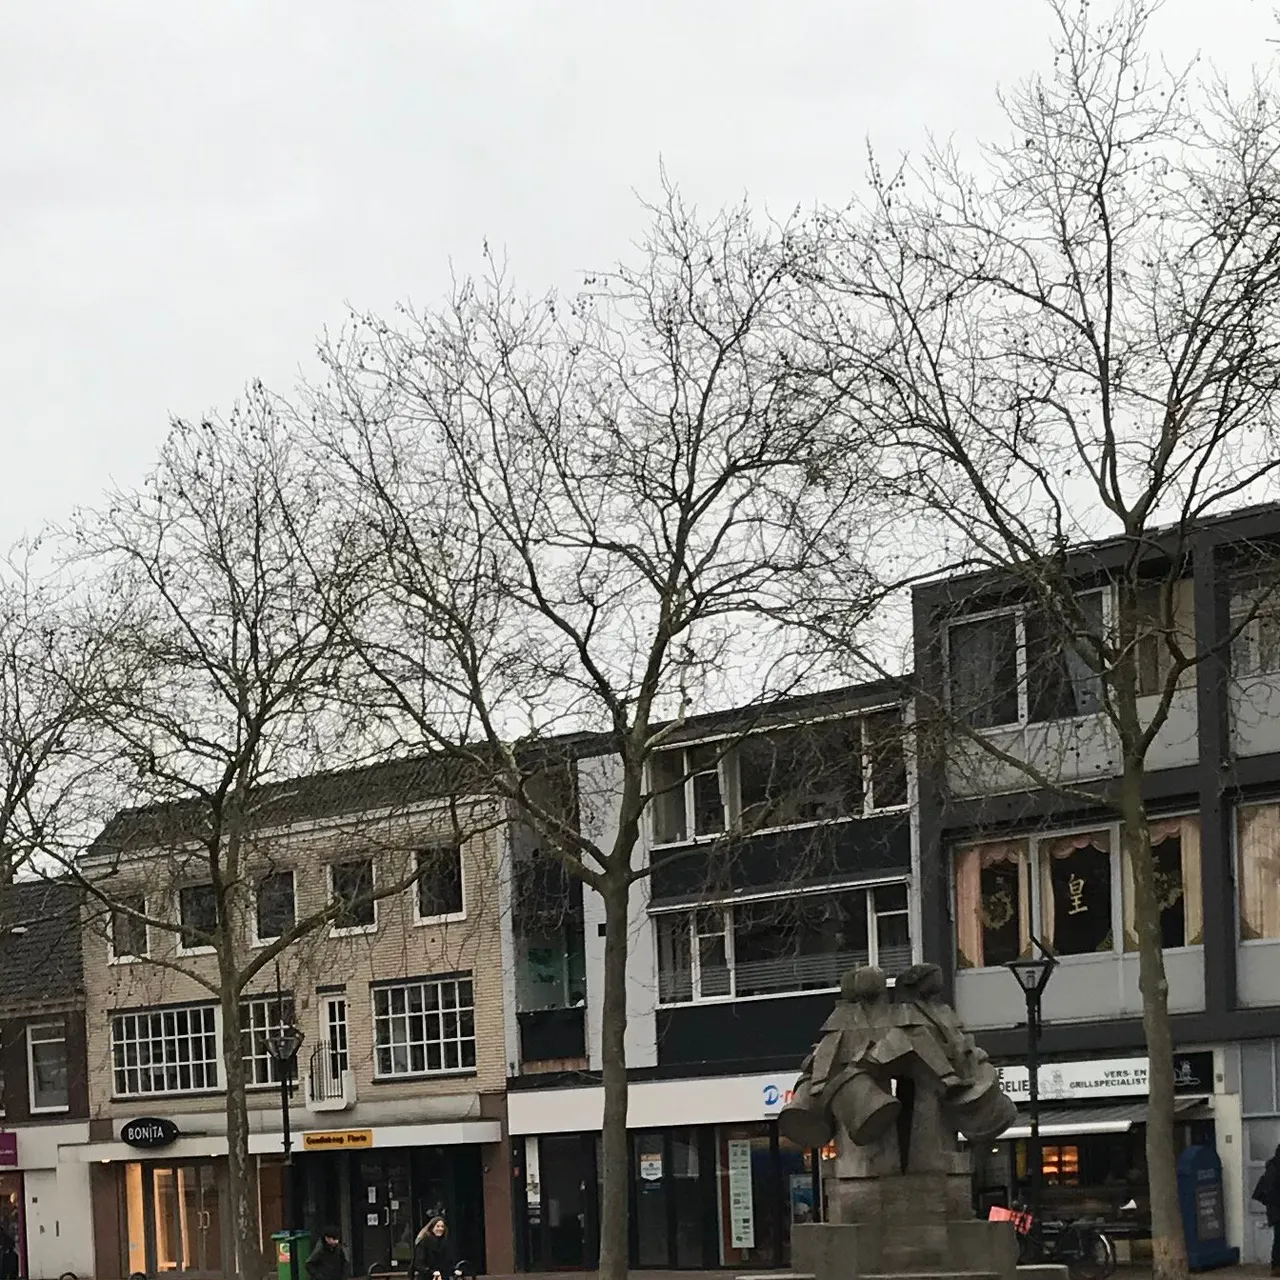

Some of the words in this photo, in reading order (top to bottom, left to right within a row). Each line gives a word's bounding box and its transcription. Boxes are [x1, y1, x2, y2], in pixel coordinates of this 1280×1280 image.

[1066, 871, 1089, 915] 皇
[1133, 1068, 1148, 1077] EN
[999, 1079, 1030, 1093] OELIE
[1069, 1077, 1148, 1089] GRILLSPECIALIST
[127, 1124, 165, 1143] BONITA
